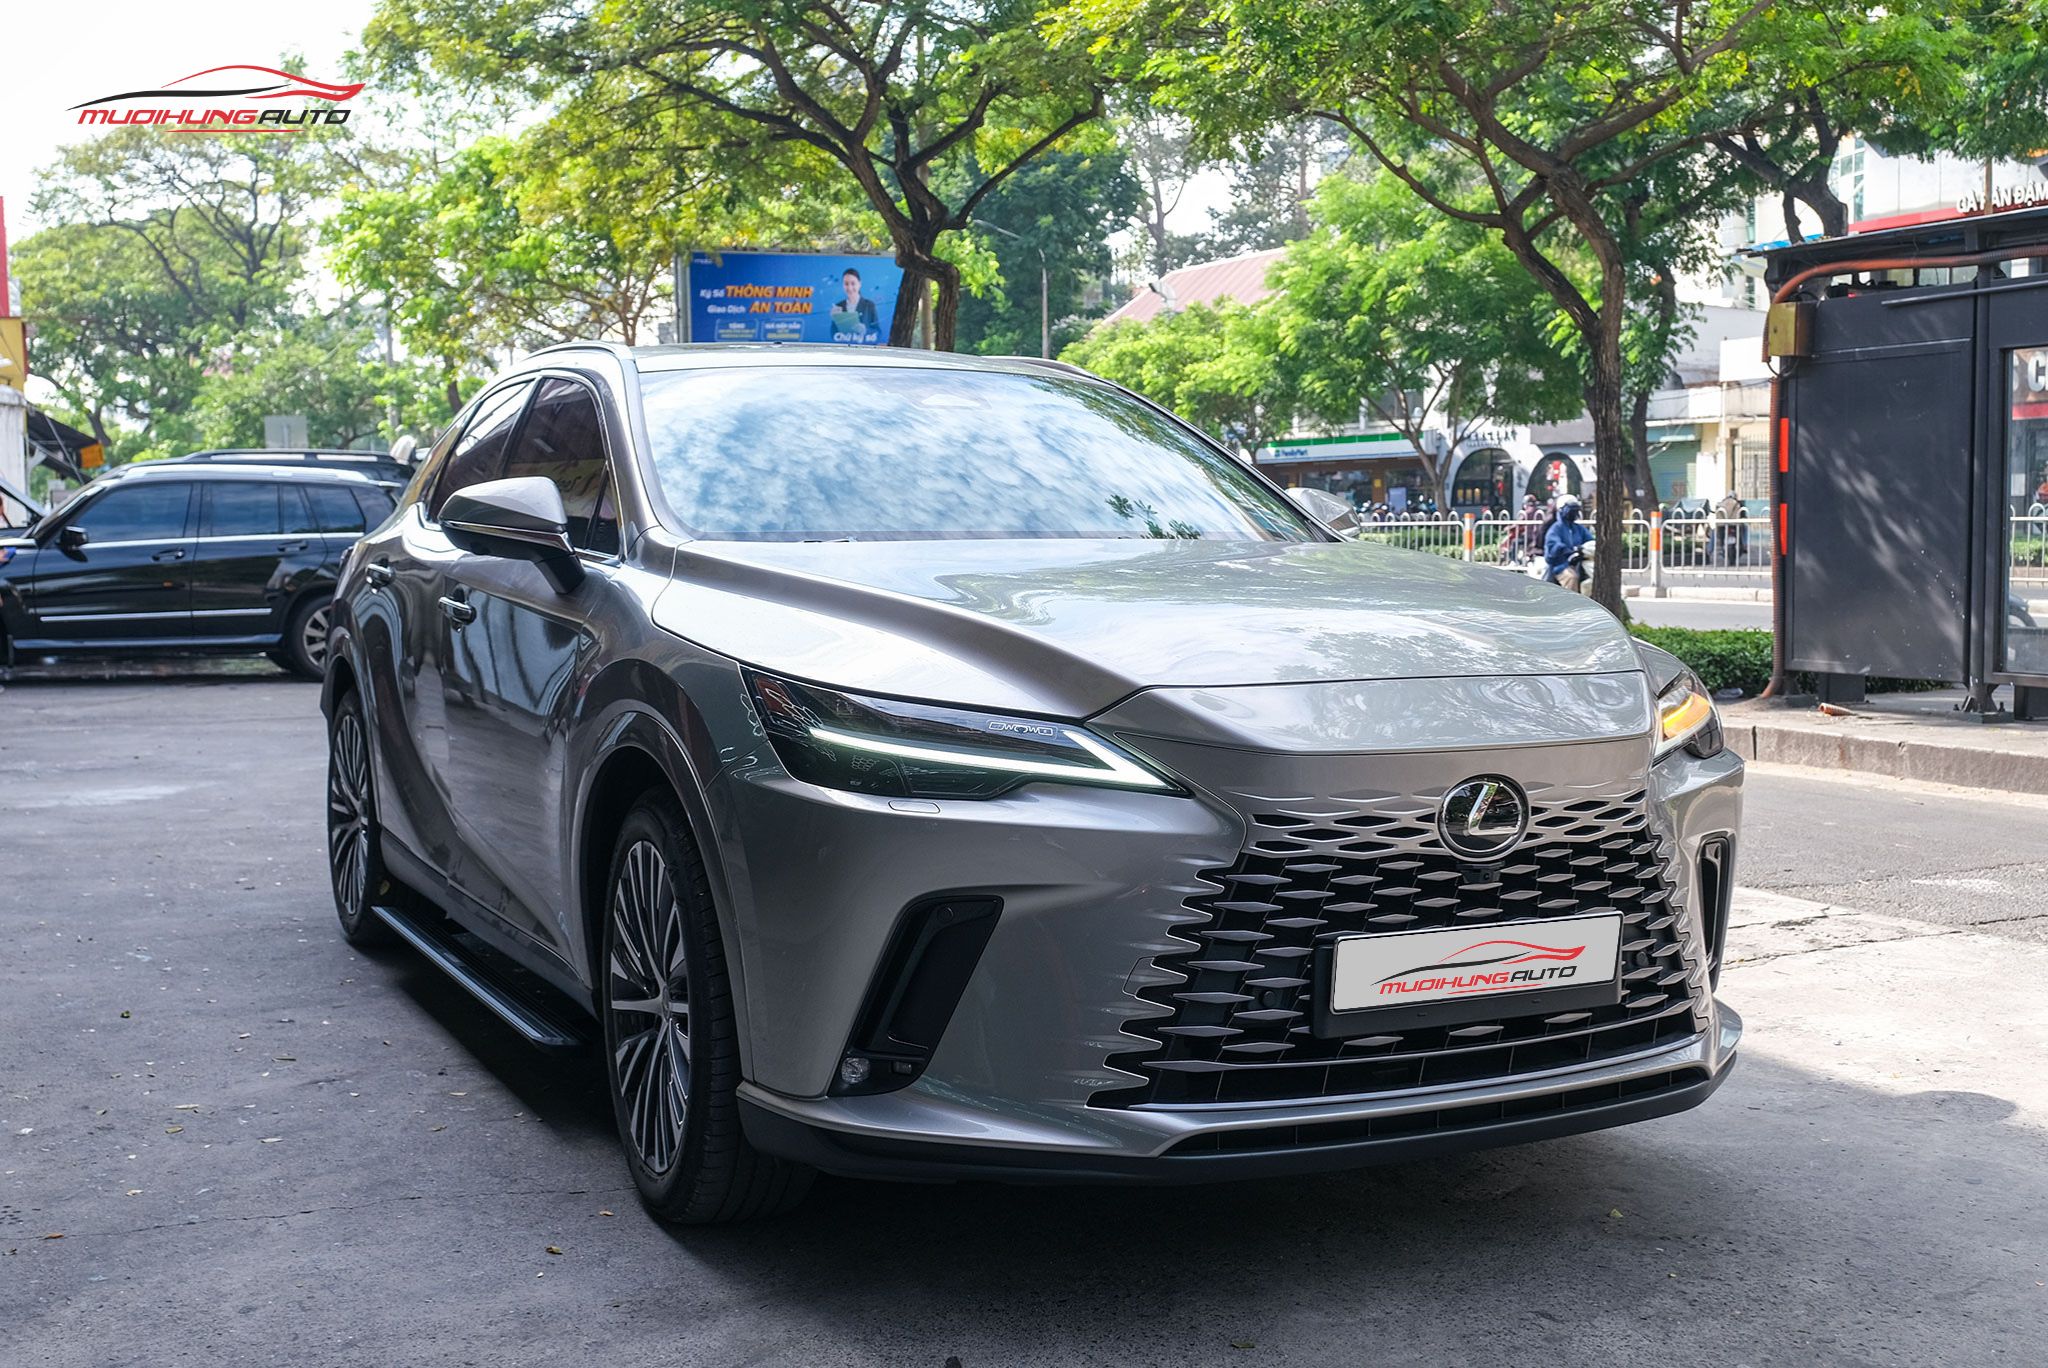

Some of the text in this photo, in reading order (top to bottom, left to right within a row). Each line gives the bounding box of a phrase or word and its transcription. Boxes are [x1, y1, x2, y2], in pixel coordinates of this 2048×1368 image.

[725, 283, 774, 298] THÔNG
[775, 286, 814, 298] MINH
[749, 301, 771, 314] AN
[773, 300, 813, 314] TOÀN
